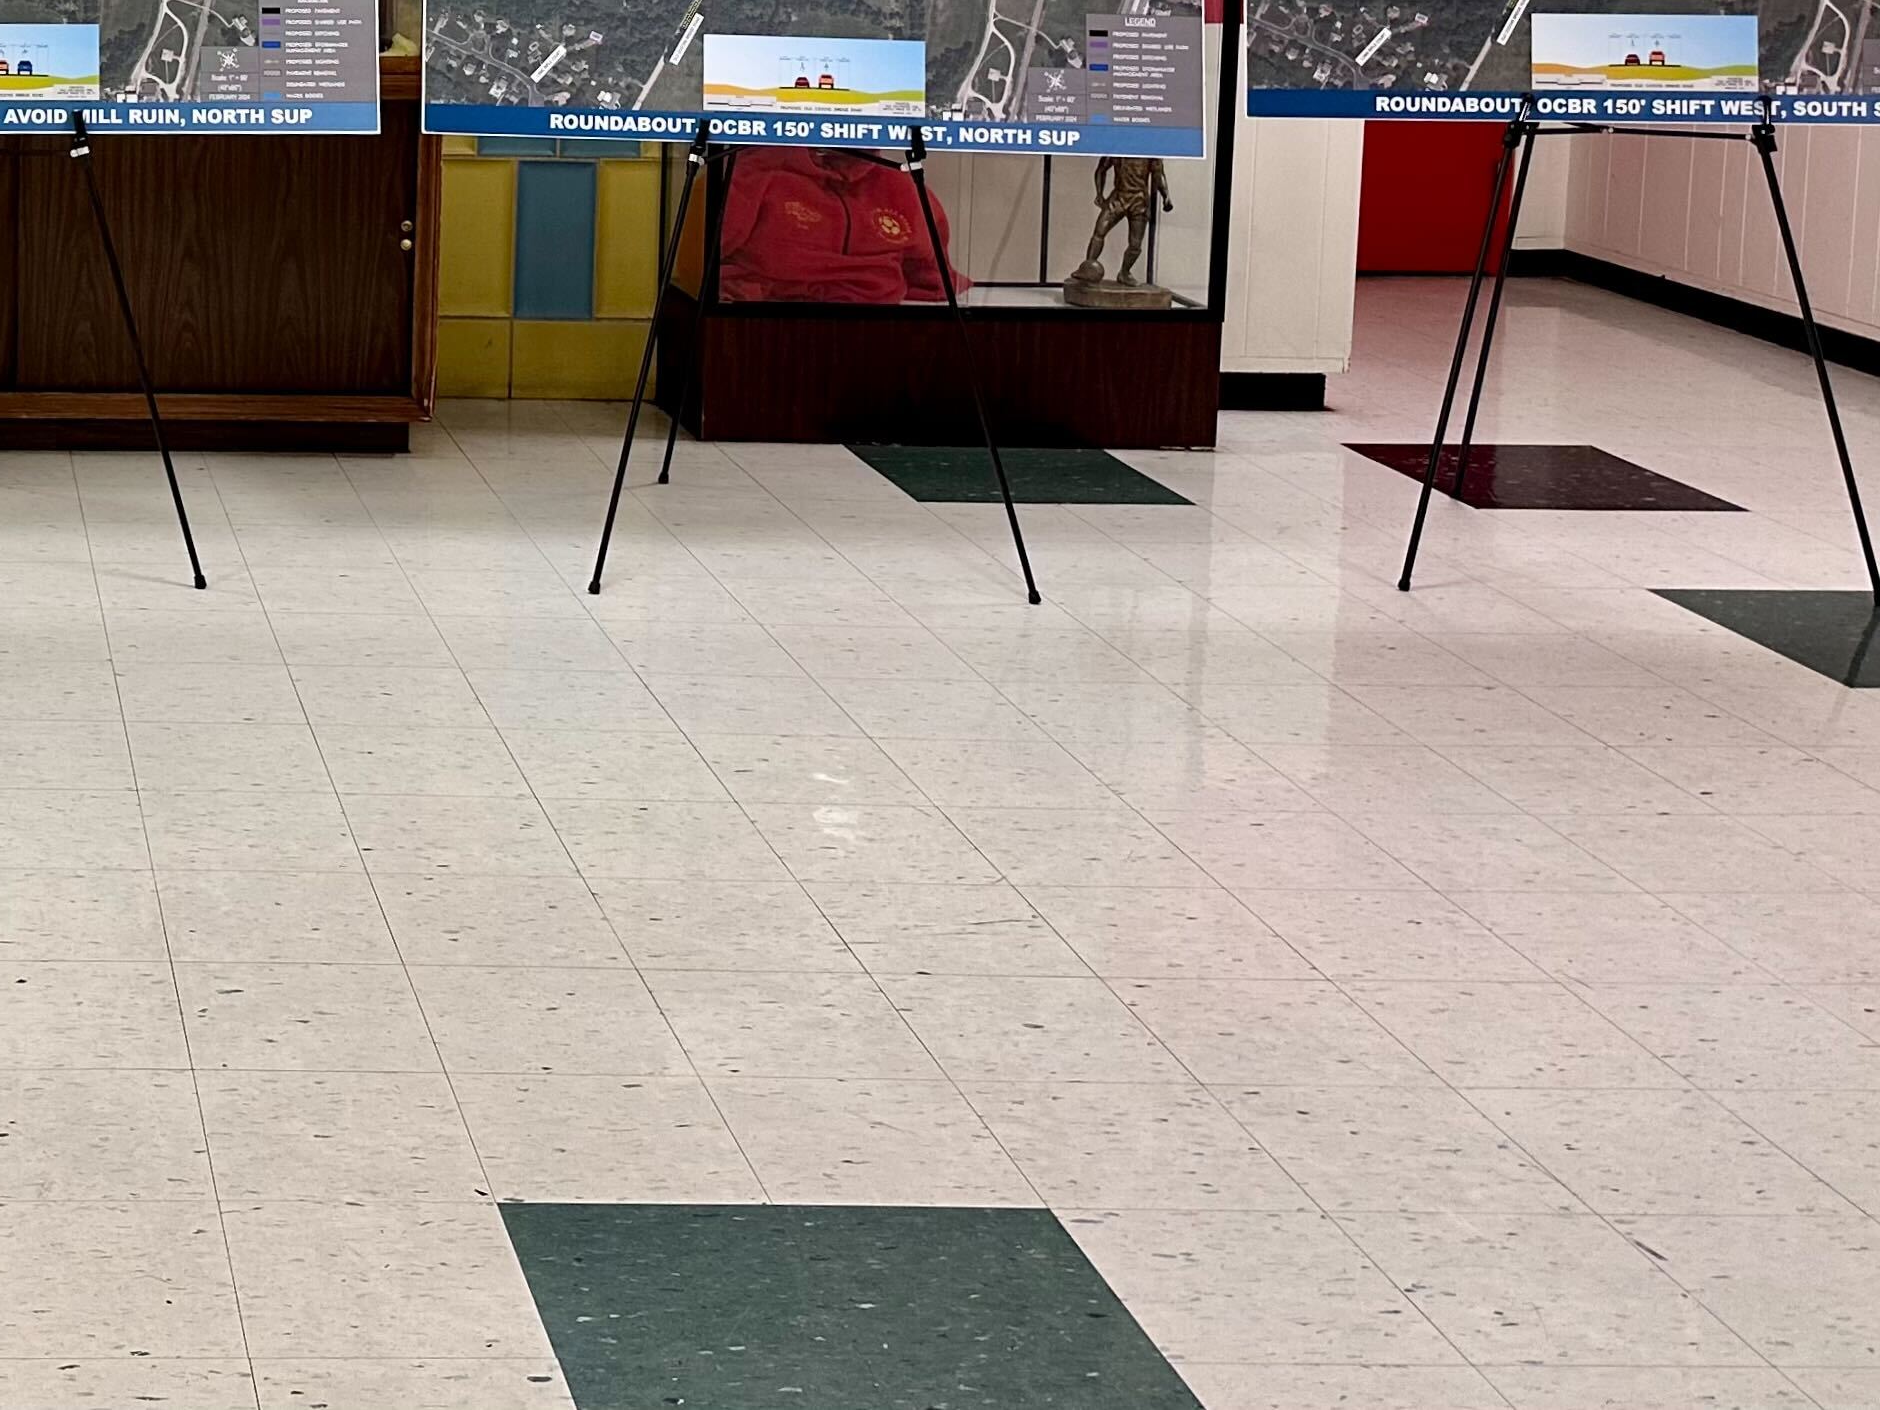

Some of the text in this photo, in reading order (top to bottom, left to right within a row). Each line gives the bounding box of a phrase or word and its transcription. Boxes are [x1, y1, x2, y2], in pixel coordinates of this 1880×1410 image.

[1124, 17, 1156, 27] LEGEND
[1537, 98, 1597, 114] OCBR
[1603, 99, 1646, 114] 150'
[1652, 100, 1715, 115] SHIFT
[1793, 101, 1867, 116] SOUTH
[4, 109, 68, 124] AVOID
[129, 109, 186, 127] RUIN,
[192, 109, 264, 124] NORTH
[271, 109, 312, 124] SUP
[709, 118, 767, 136] OCBR
[773, 120, 814, 137] 150'
[820, 123, 882, 139] SHIFT
[959, 127, 1032, 144] NORTH
[1039, 130, 1080, 146] SUP
